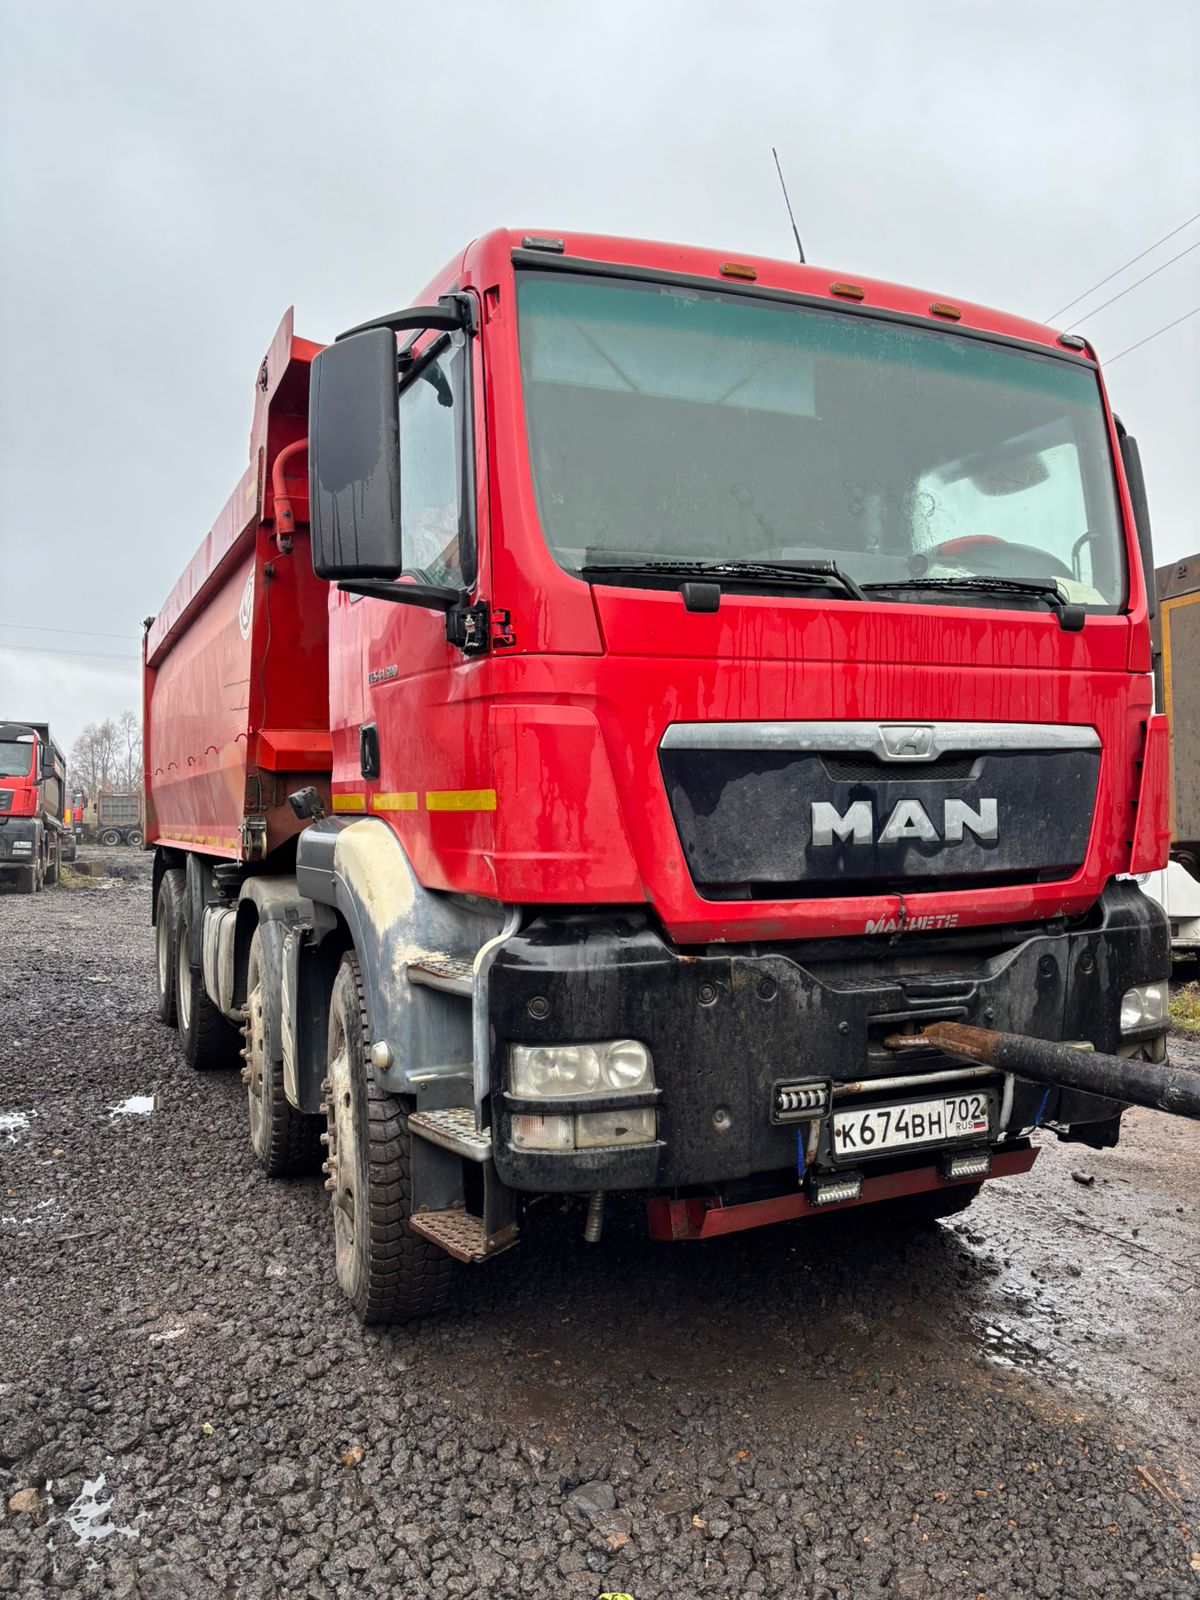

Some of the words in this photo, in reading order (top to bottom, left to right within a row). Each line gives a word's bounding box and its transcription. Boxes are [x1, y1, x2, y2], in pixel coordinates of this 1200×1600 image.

[812, 798, 998, 845] MAN
[946, 1097, 981, 1123] 702
[956, 1120, 973, 1131] RUS
